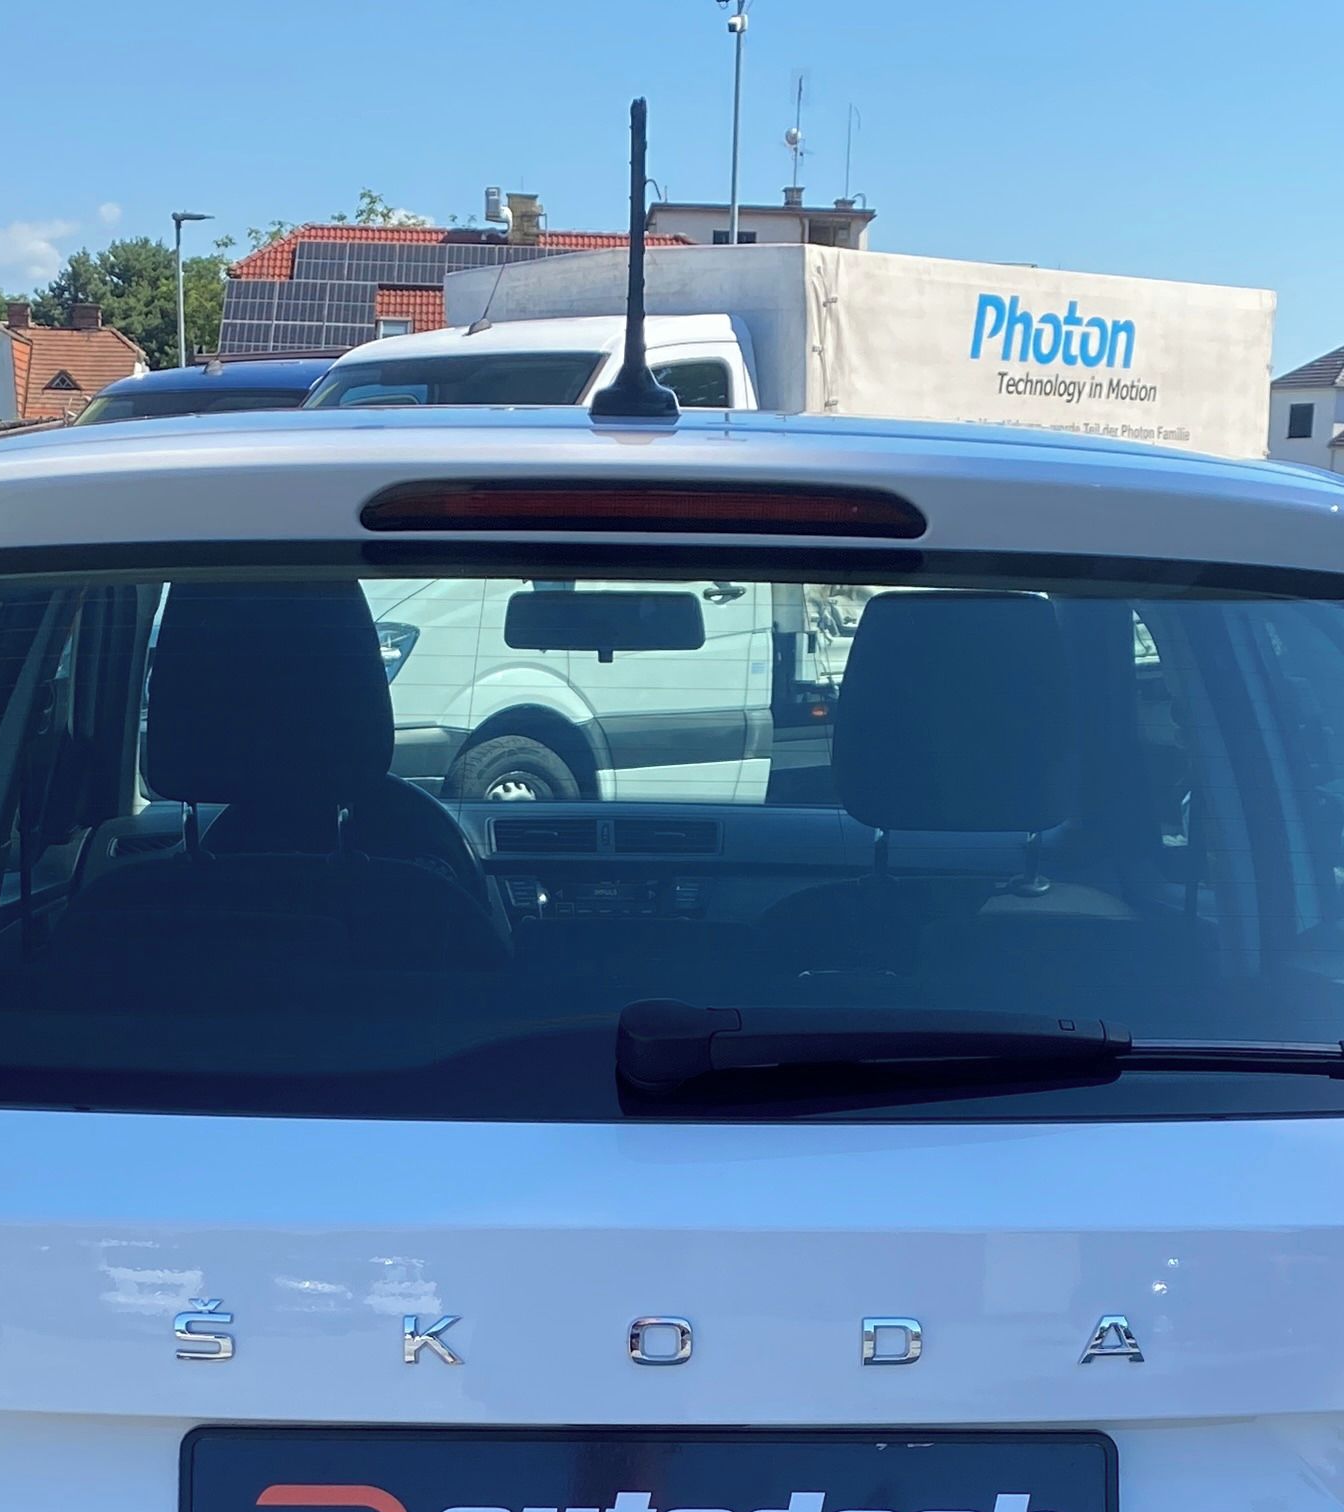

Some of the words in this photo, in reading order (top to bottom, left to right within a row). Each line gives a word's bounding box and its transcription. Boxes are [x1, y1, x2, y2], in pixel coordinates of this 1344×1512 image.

[970, 293, 1136, 369] Photon
[998, 371, 1085, 403] Technology
[1088, 376, 1103, 399] in
[1107, 377, 1157, 402] Motion
[1121, 424, 1155, 440] Photon
[1157, 425, 1190, 441] Familie
[173, 1298, 1145, 1366] ŠKODA
